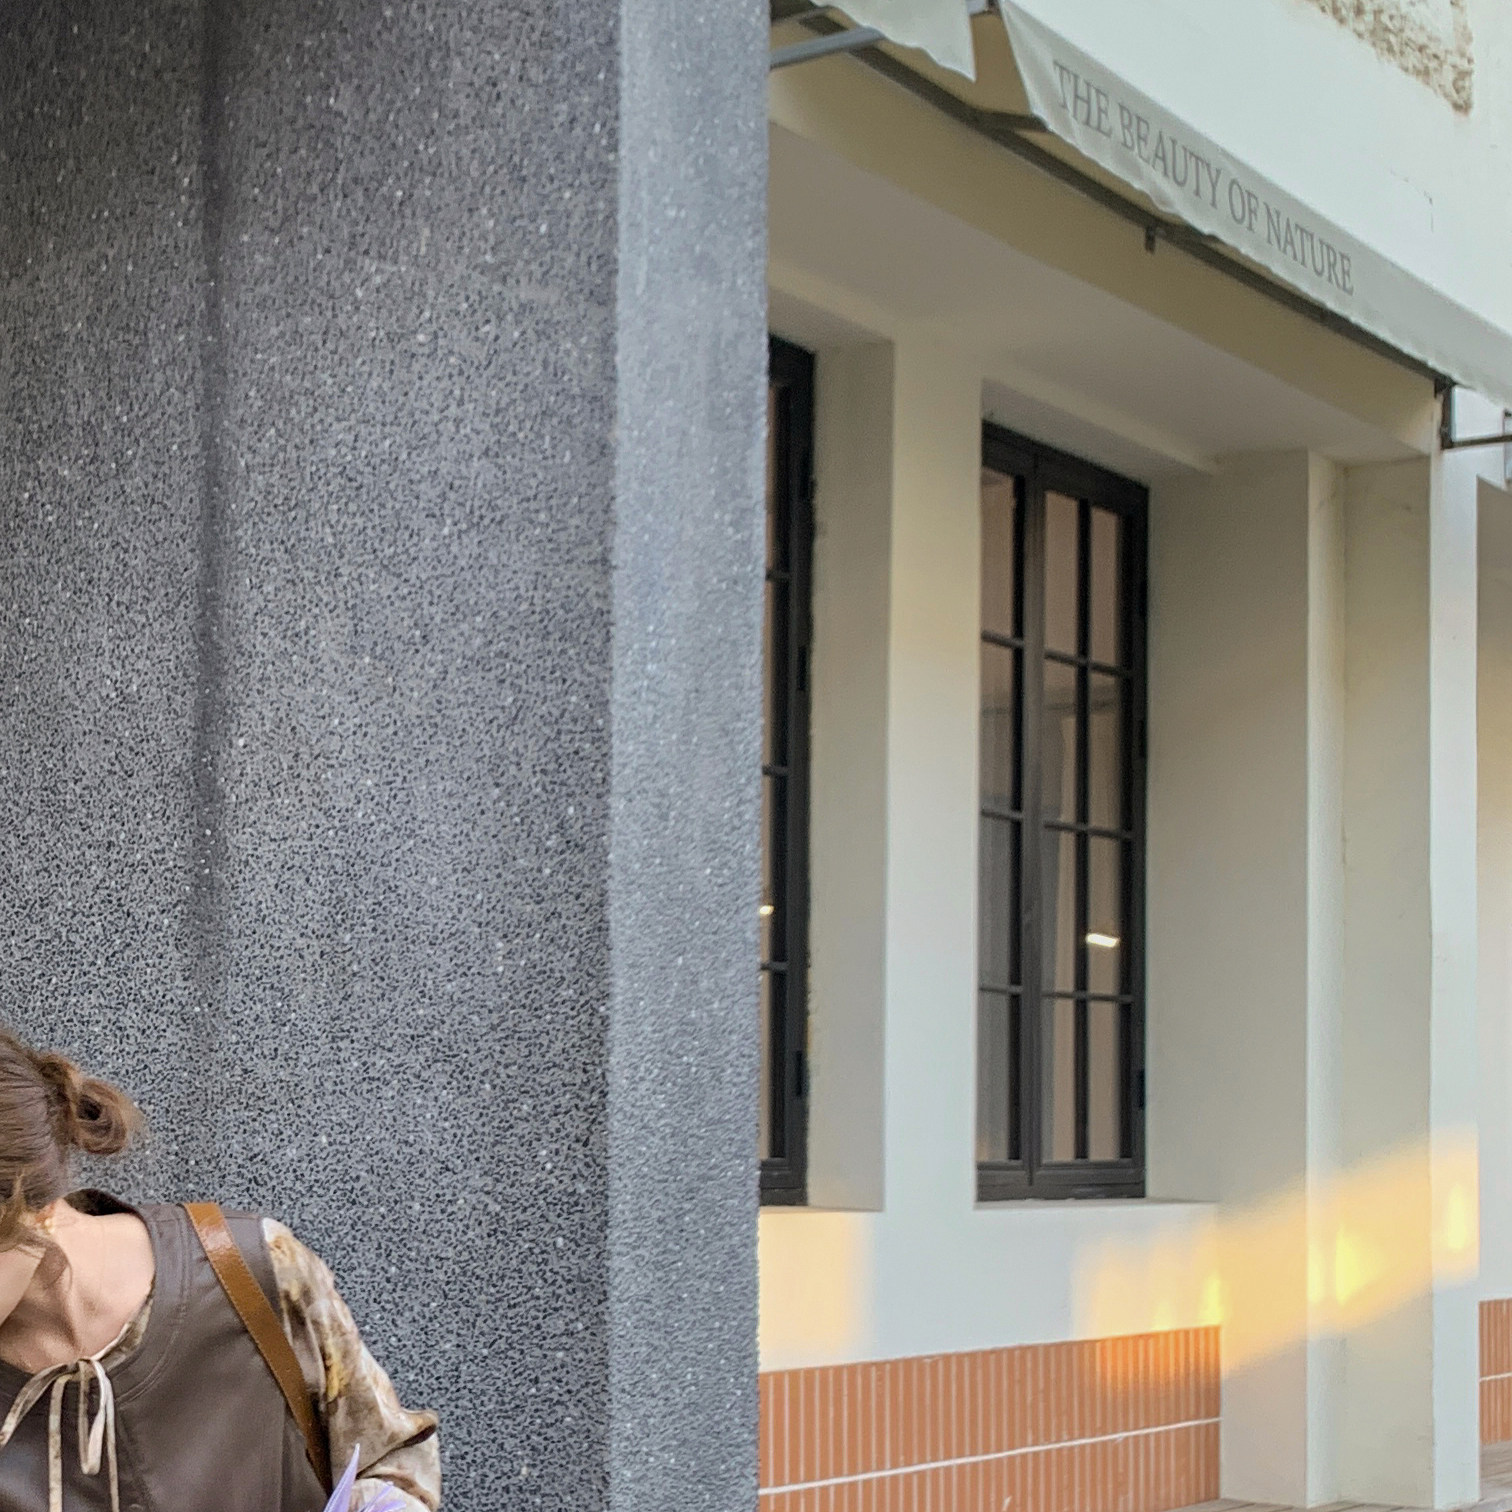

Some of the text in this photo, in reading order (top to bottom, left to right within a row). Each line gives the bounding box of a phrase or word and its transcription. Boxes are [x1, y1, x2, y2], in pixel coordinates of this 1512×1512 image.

[1053, 60, 1354, 296] THE BEAUTY OF NATURE
